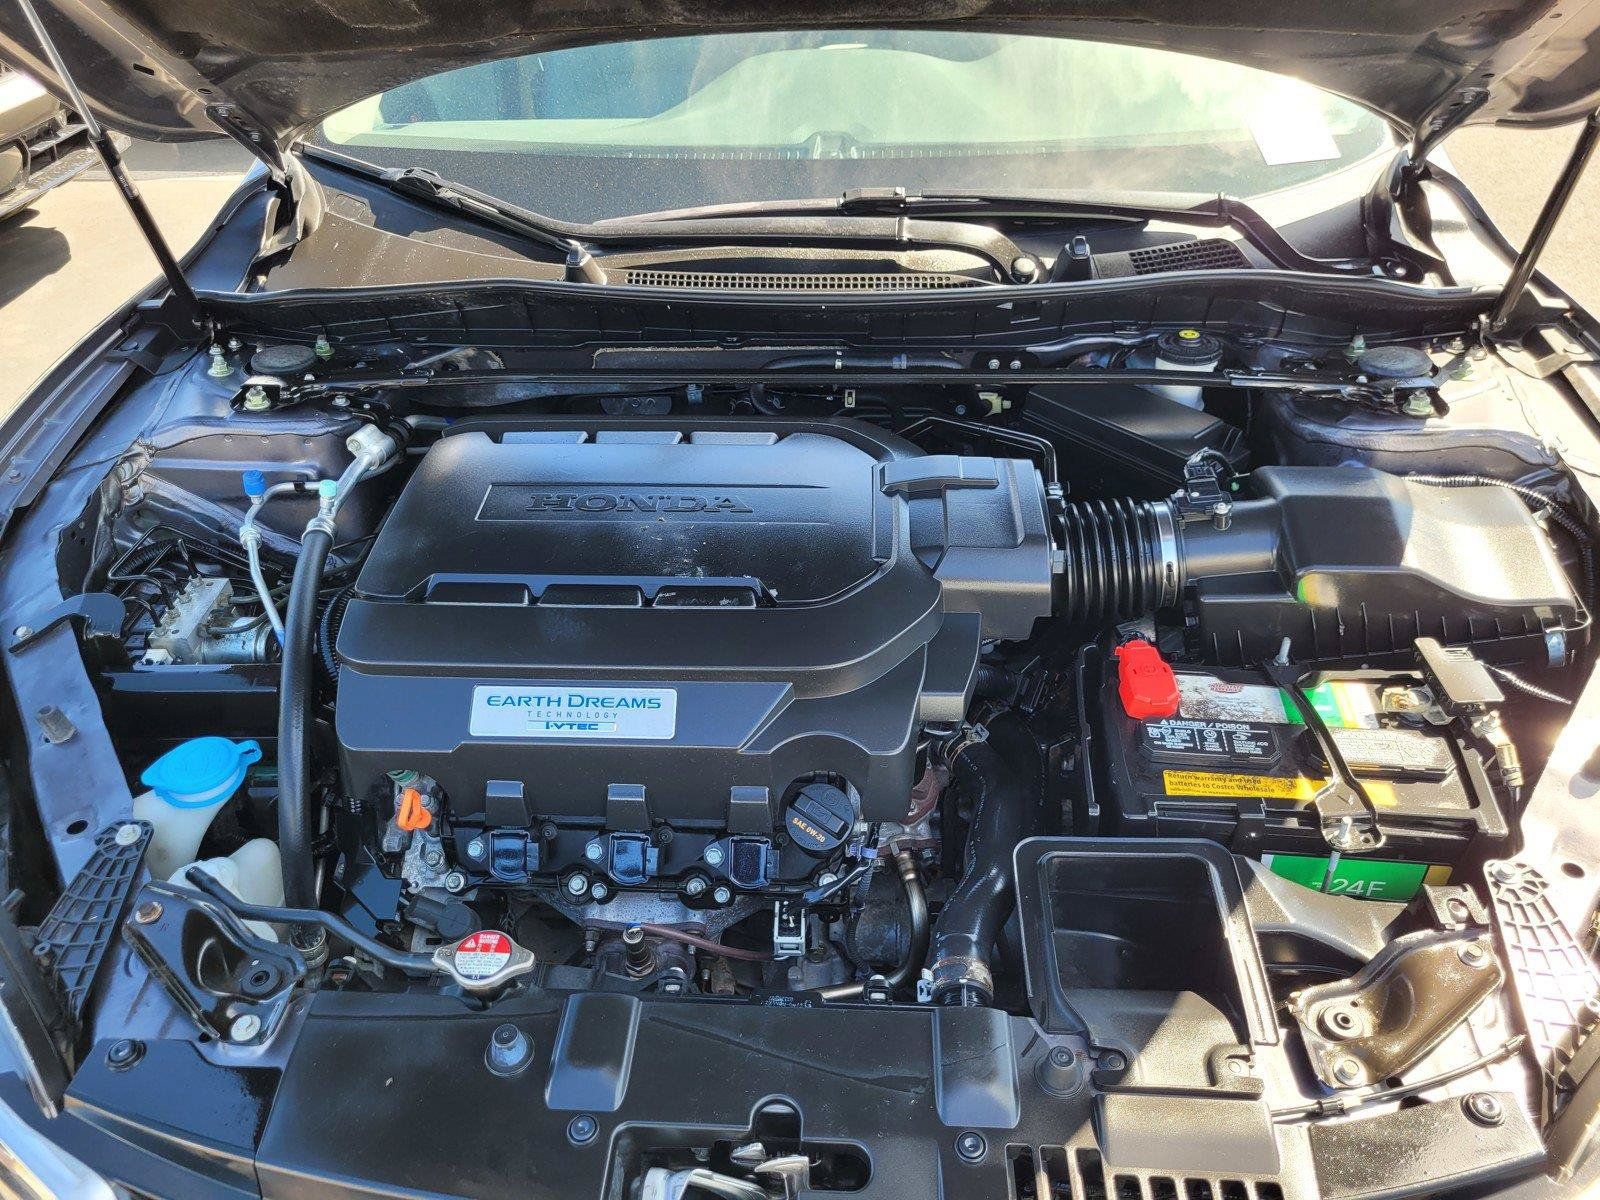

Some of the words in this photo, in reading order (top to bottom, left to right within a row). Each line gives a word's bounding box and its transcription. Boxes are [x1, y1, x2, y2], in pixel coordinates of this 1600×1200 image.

[525, 493, 754, 513] HONDA
[486, 695, 562, 708] EARTH
[568, 694, 662, 709] DREAMS
[527, 710, 619, 719] TECHNOLOGY
[1171, 720, 1207, 728] DANGER
[1168, 772, 1190, 780] Return
[1169, 780, 1201, 788] batteries
[1237, 785, 1275, 793] Wholesale
[792, 817, 808, 830] SAE
[806, 826, 826, 843] 0W-20
[1332, 878, 1387, 897] 24F
